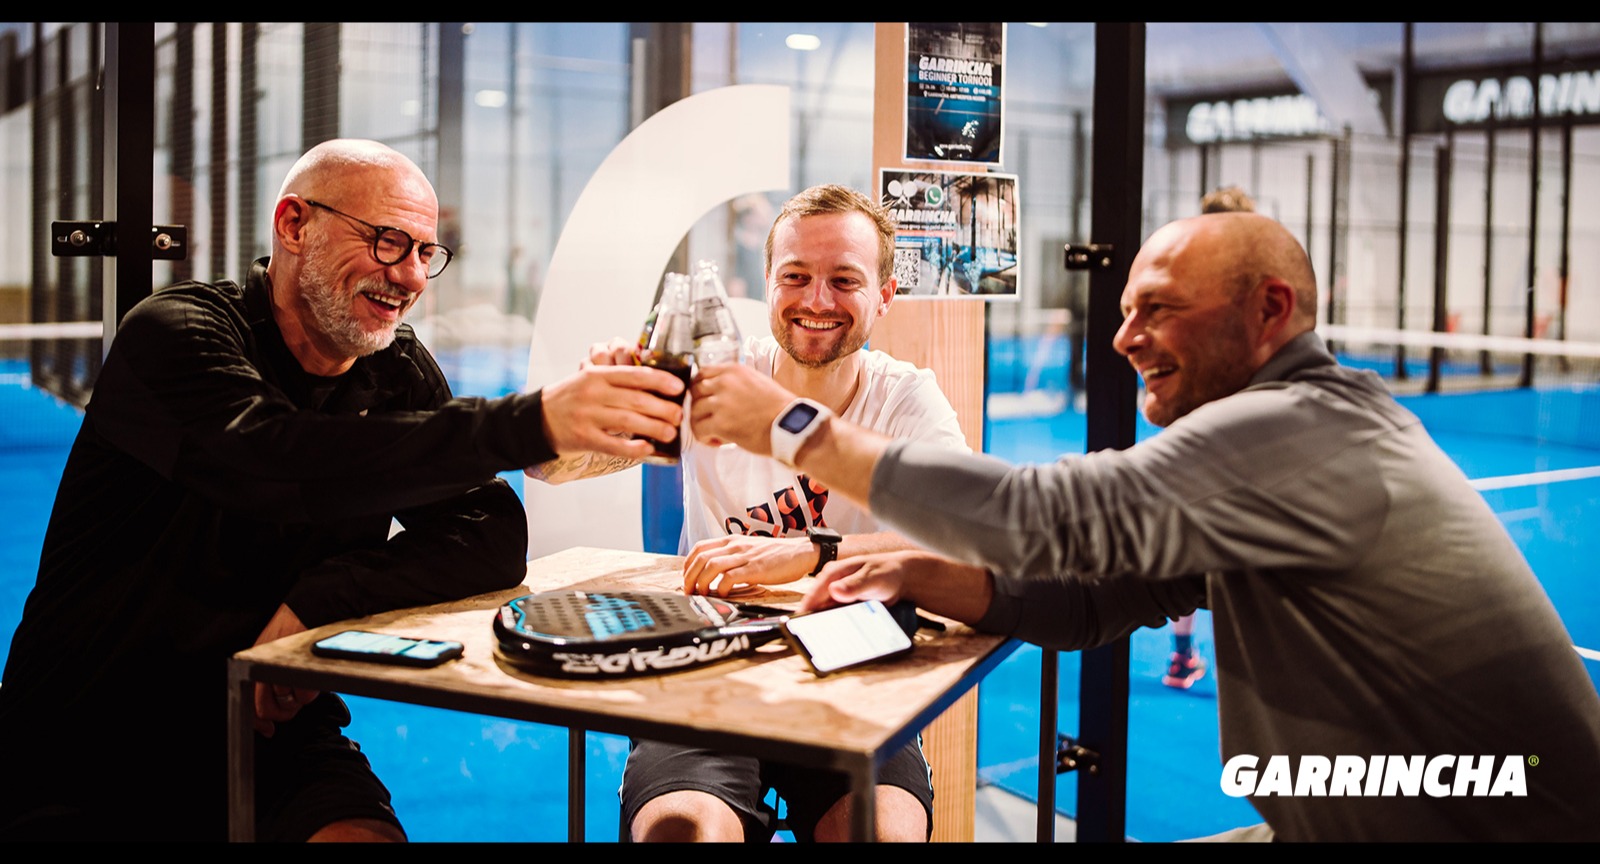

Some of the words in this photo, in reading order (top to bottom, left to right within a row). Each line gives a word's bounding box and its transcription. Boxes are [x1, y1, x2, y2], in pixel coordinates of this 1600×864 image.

[919, 56, 993, 77] GARRINCHA
[918, 70, 957, 83] BEGINNER
[959, 75, 993, 87] TORNOOI
